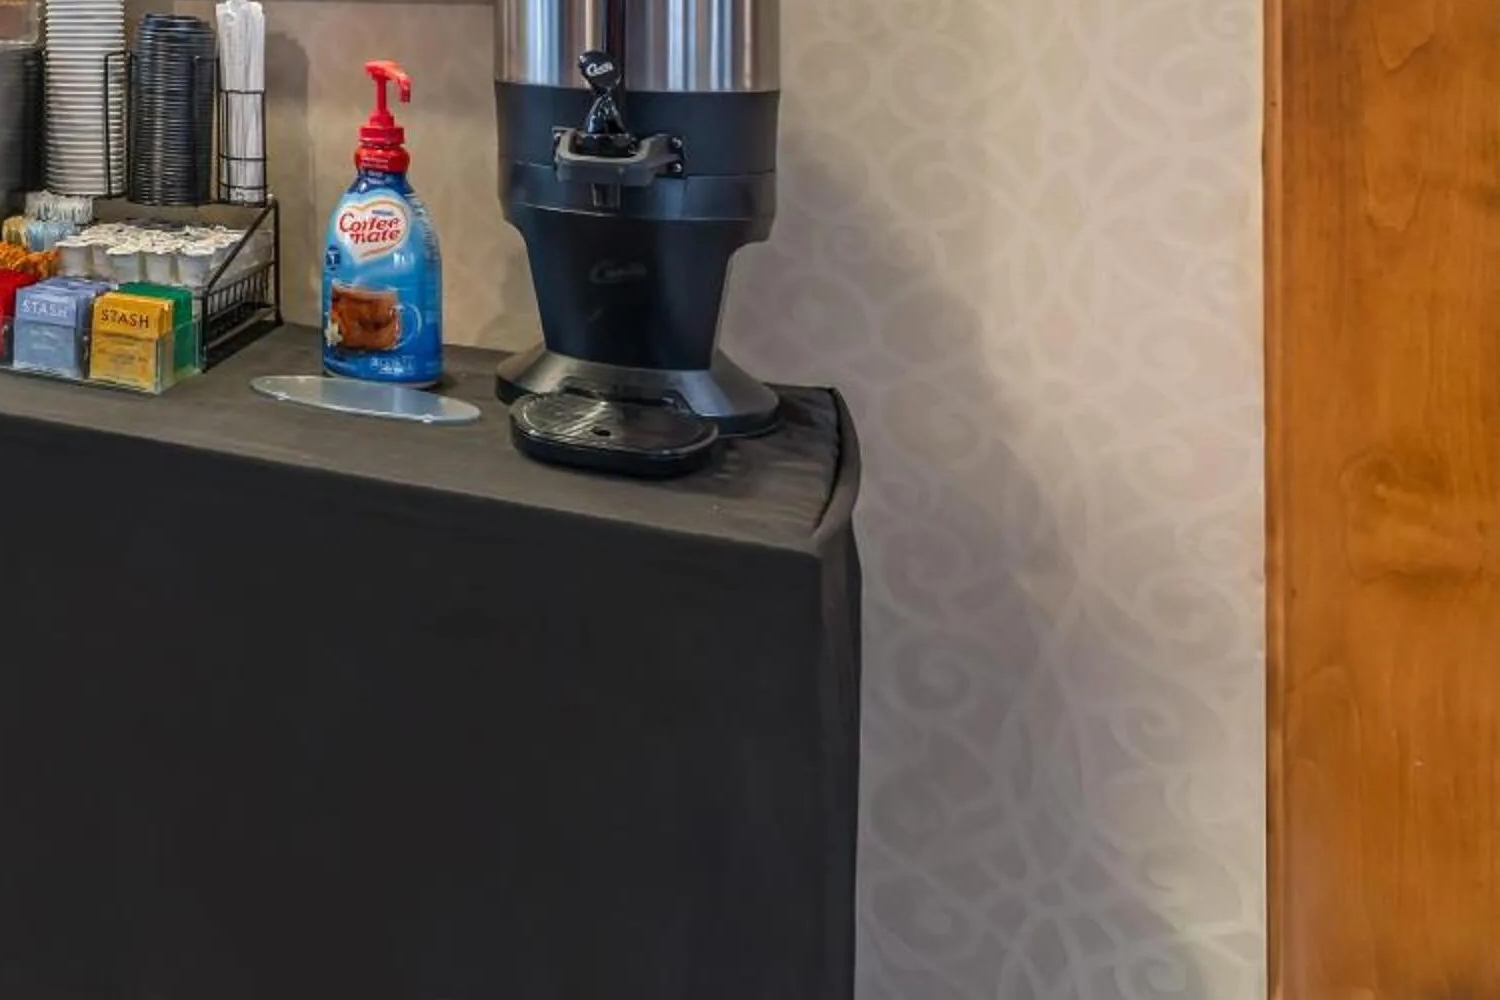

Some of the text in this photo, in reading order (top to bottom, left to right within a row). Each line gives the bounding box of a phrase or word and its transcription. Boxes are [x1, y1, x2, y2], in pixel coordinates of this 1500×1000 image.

[339, 212, 401, 232] Coffee
[350, 229, 401, 244] mate
[23, 300, 68, 318] STASH
[101, 309, 149, 329] STASH
